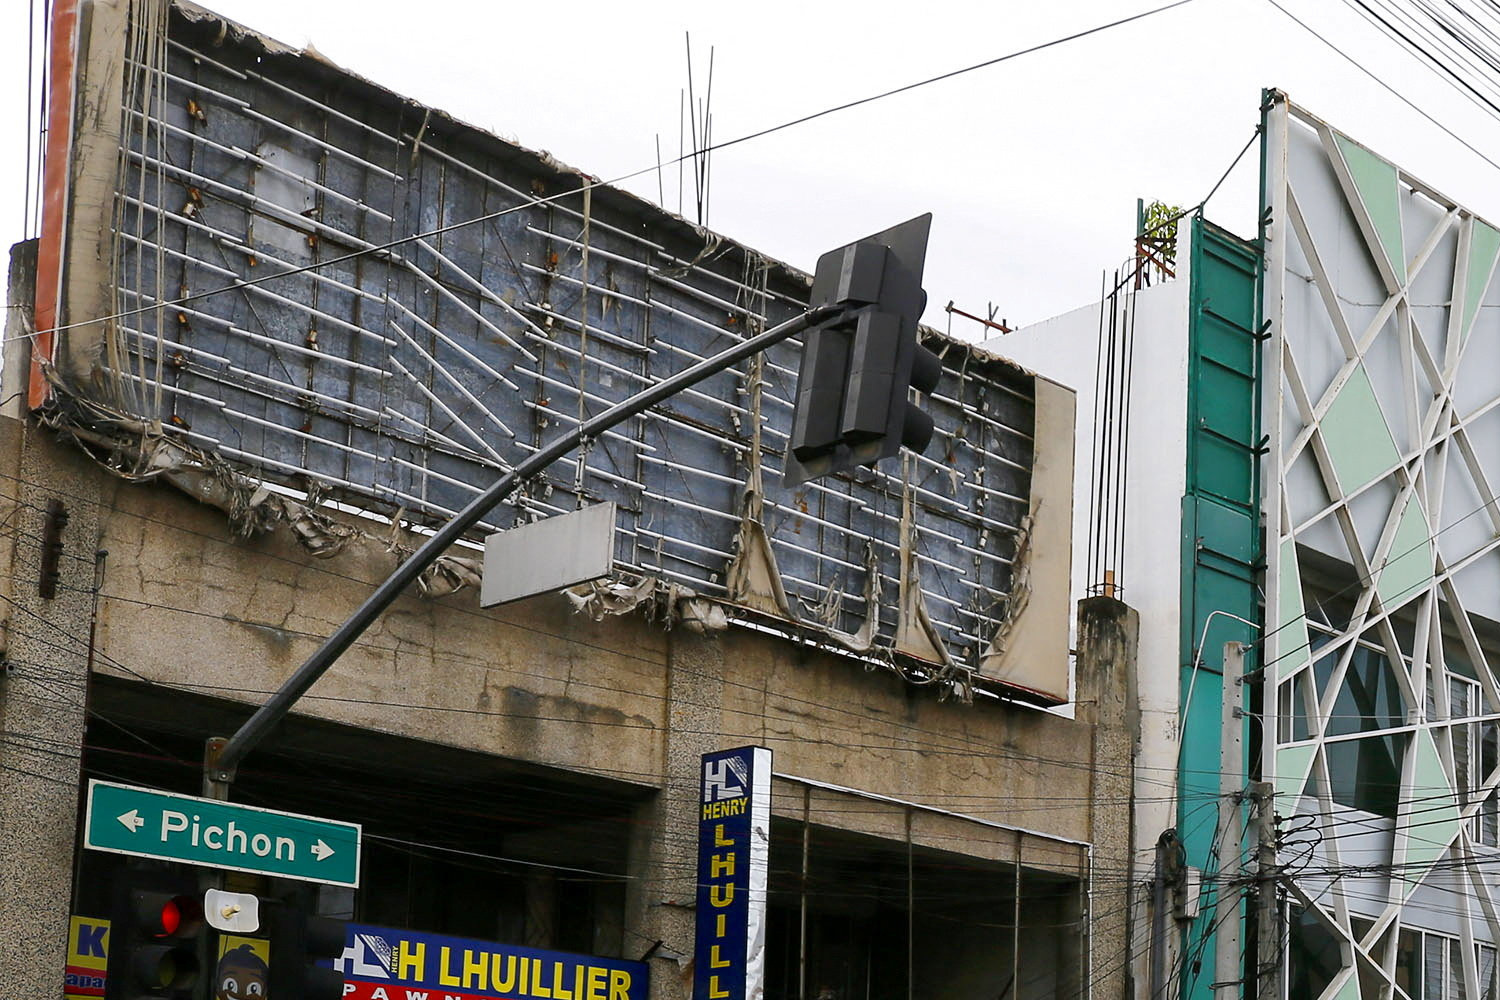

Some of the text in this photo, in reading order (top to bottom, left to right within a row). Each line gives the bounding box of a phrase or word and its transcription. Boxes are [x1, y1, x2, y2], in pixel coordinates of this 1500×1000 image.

[702, 796, 749, 821] HENRY
[160, 809, 297, 861] Pichon
[391, 945, 399, 974] HENRY
[398, 940, 426, 982] H
